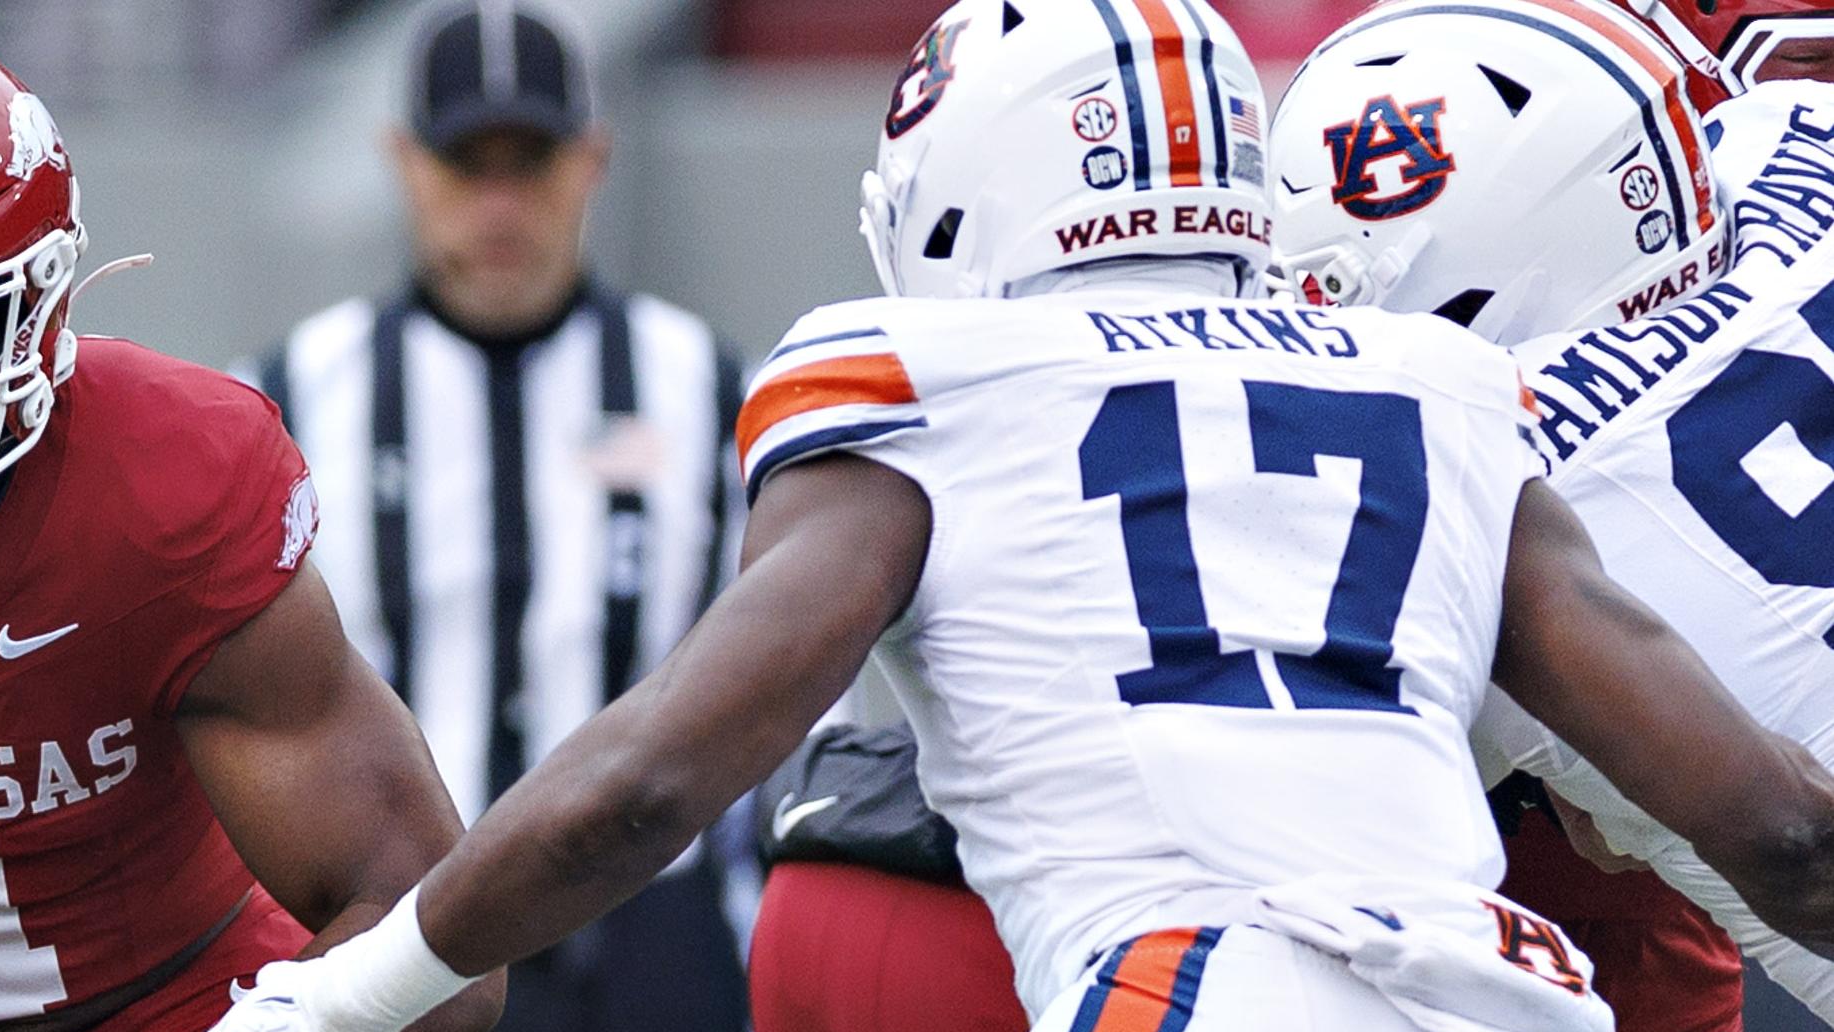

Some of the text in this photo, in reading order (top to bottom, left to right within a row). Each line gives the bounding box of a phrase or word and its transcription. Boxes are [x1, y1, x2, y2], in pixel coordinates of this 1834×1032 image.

[1075, 100, 1116, 140] SEC
[1175, 125, 1191, 144] 17
[1623, 167, 1657, 208] SEC
[1055, 205, 1273, 254] WAR EAGLE
[1616, 261, 1700, 323] WAR
[1086, 307, 1360, 358] ATKINS
[1532, 282, 1754, 477] AMISON
[1078, 378, 1430, 718] 17
